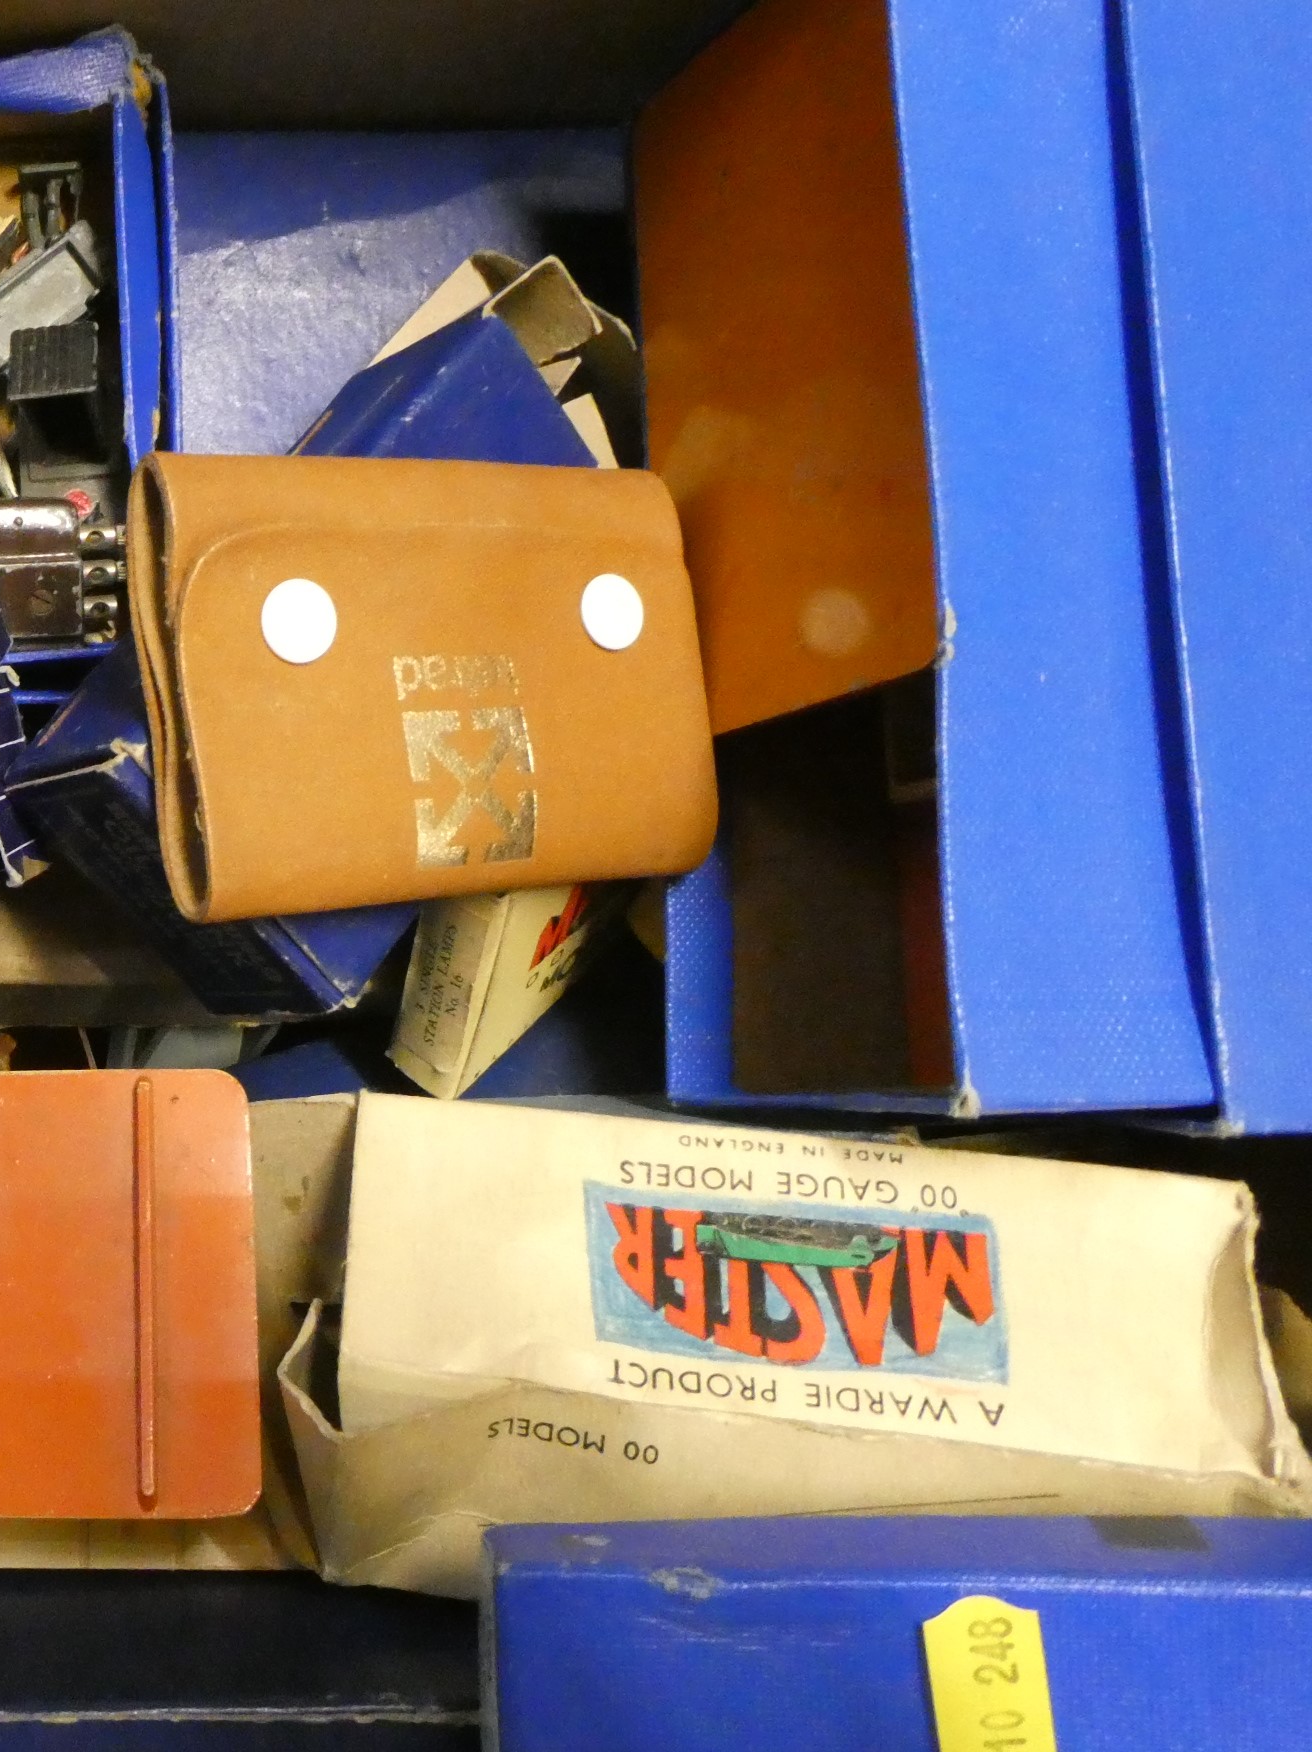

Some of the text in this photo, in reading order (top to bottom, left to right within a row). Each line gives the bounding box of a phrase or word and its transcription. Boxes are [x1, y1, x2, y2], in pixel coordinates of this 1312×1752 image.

[423, 924, 457, 1047] STATION LAMPS
[619, 1159, 754, 1193] MODELS
[678, 1134, 904, 1165] MADE IN ENGLAND
[776, 1171, 900, 1205] GAUGE
[604, 1200, 995, 1367] MASTER
[610, 1358, 1006, 1428] A WARDIE PRODUCT
[487, 1417, 606, 1454] MODELS
[968, 1616, 1019, 1685] 248
